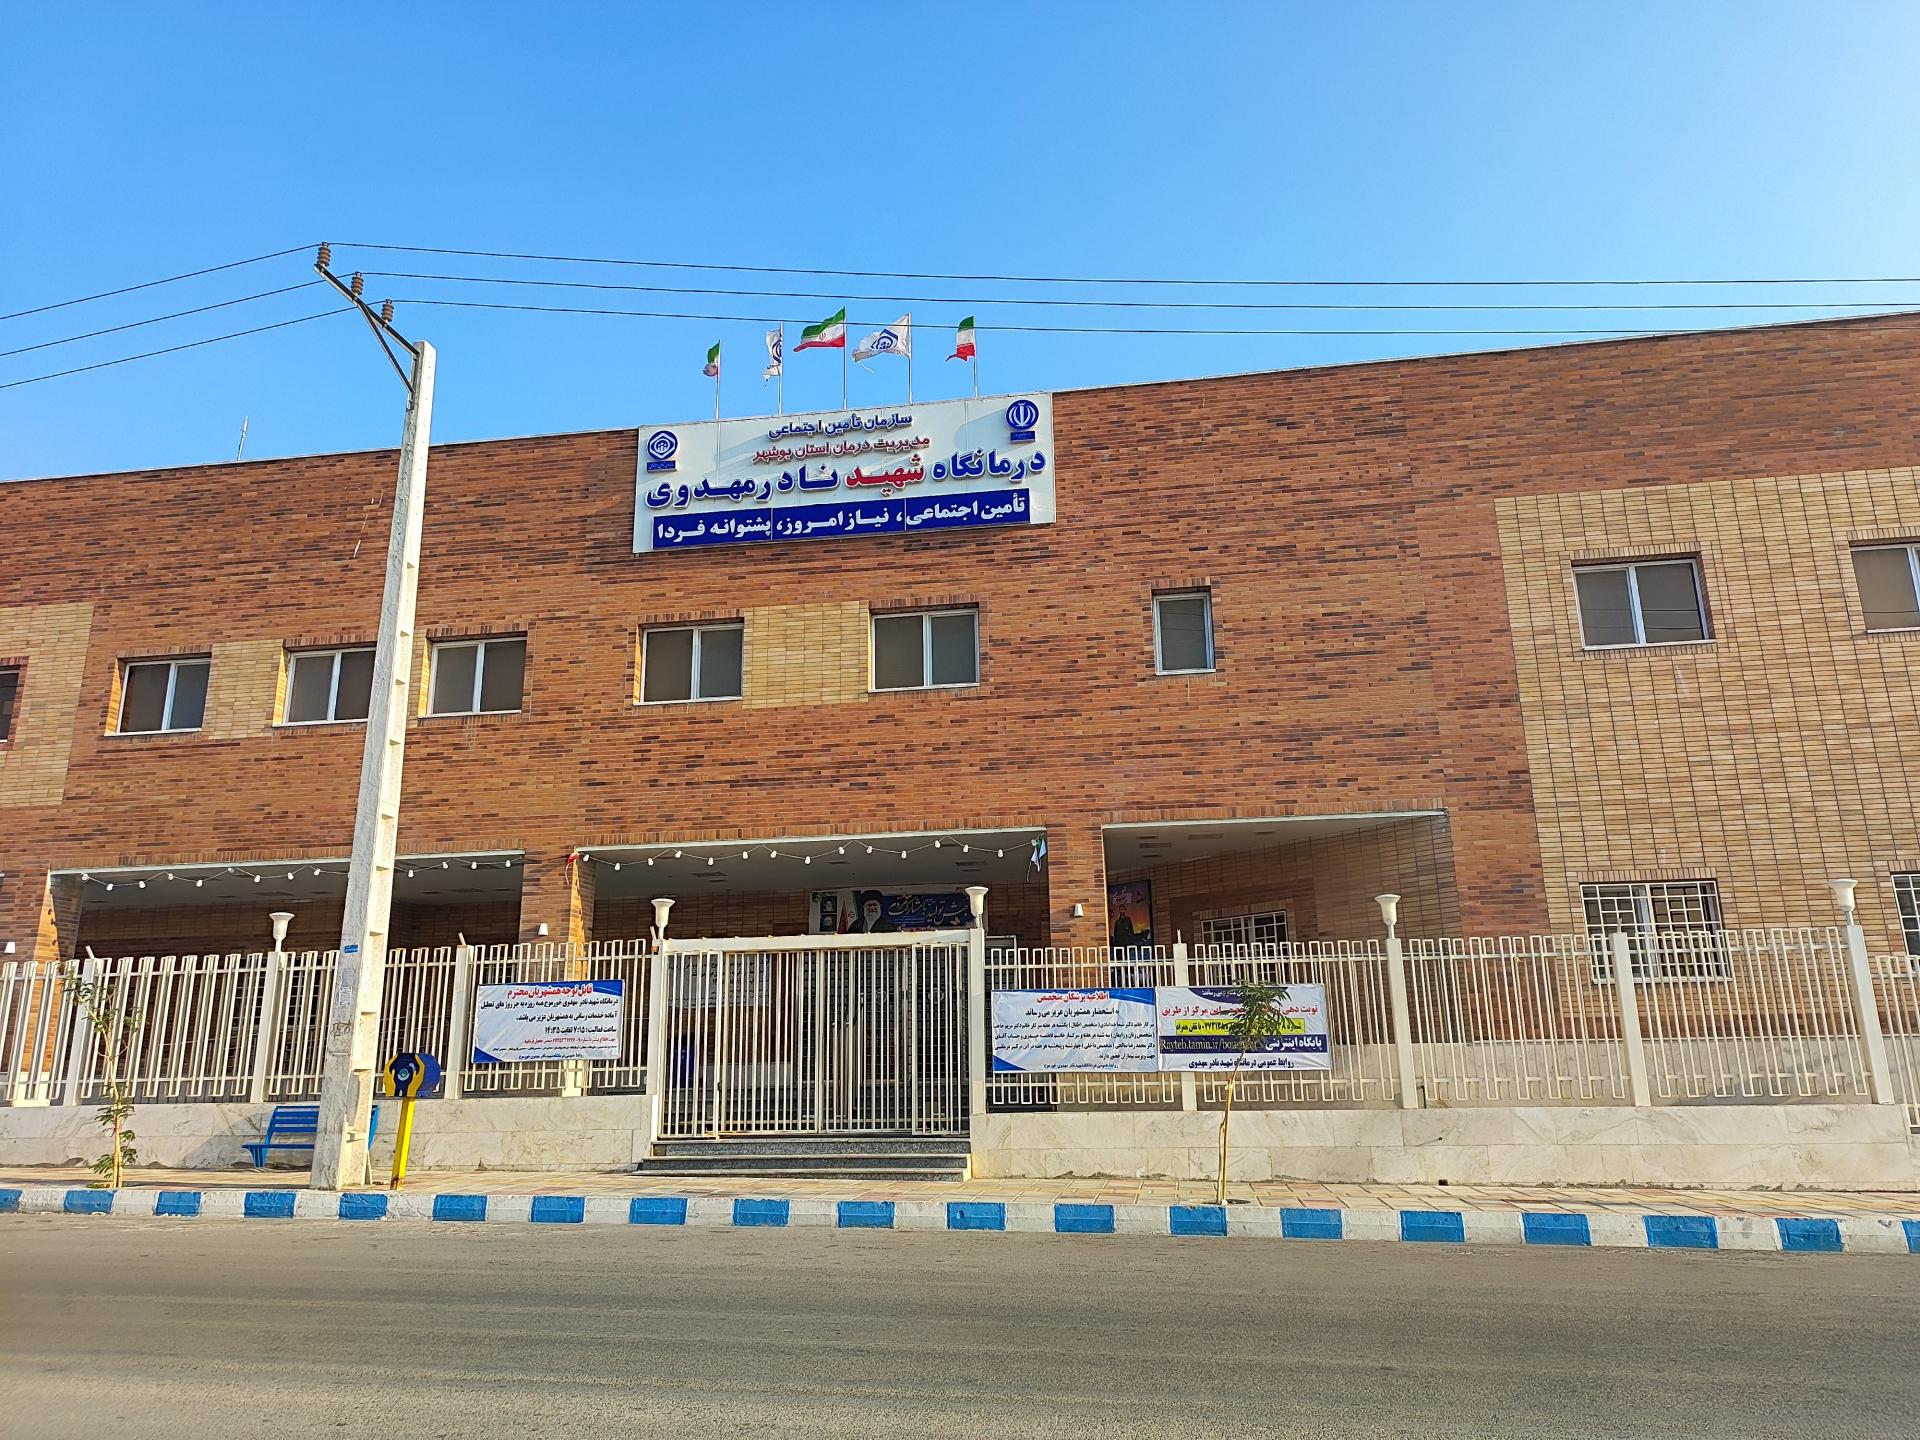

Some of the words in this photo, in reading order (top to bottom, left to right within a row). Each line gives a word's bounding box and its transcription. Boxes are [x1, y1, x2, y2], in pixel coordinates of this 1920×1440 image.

[825, 413, 861, 434] تأمین
[864, 412, 912, 430] سازمان
[768, 419, 822, 439] اجتماعی
[833, 440, 870, 455] درمان
[874, 434, 930, 451] مدیریت
[753, 445, 792, 463] بوشهر
[795, 443, 829, 458] استان
[932, 448, 1047, 482] درمانگاه
[845, 453, 926, 497] شهید
[754, 463, 839, 503] نادر
[645, 477, 757, 509] مهدوی
[981, 493, 1026, 519] تأمین
[844, 507, 890, 531] نیاز
[657, 520, 706, 543] فردا
[709, 516, 772, 538] پشتوانه
[507, 988, 528, 999] محترم
[528, 985, 561, 999] همشهریان
[561, 985, 578, 998] توجه
[578, 983, 593, 997] قابل
[1037, 992, 1062, 1003] متخصص
[1064, 991, 1086, 1003] پزشکان
[1087, 991, 1109, 1001] اطلاعیه
[1064, 1007, 1090, 1018] همشهریان
[1091, 1007, 1115, 1017] استحضار
[1162, 1005, 1182, 1017] طریق
[1183, 1005, 1190, 1016] از
[1299, 1036, 1322, 1051] پایگاه
[1188, 1058, 1208, 1069] مهدوی
[1220, 1058, 1233, 1068] شهید
[1257, 1057, 1276, 1069] عمومی
[1278, 1057, 1294, 1068] روابط
